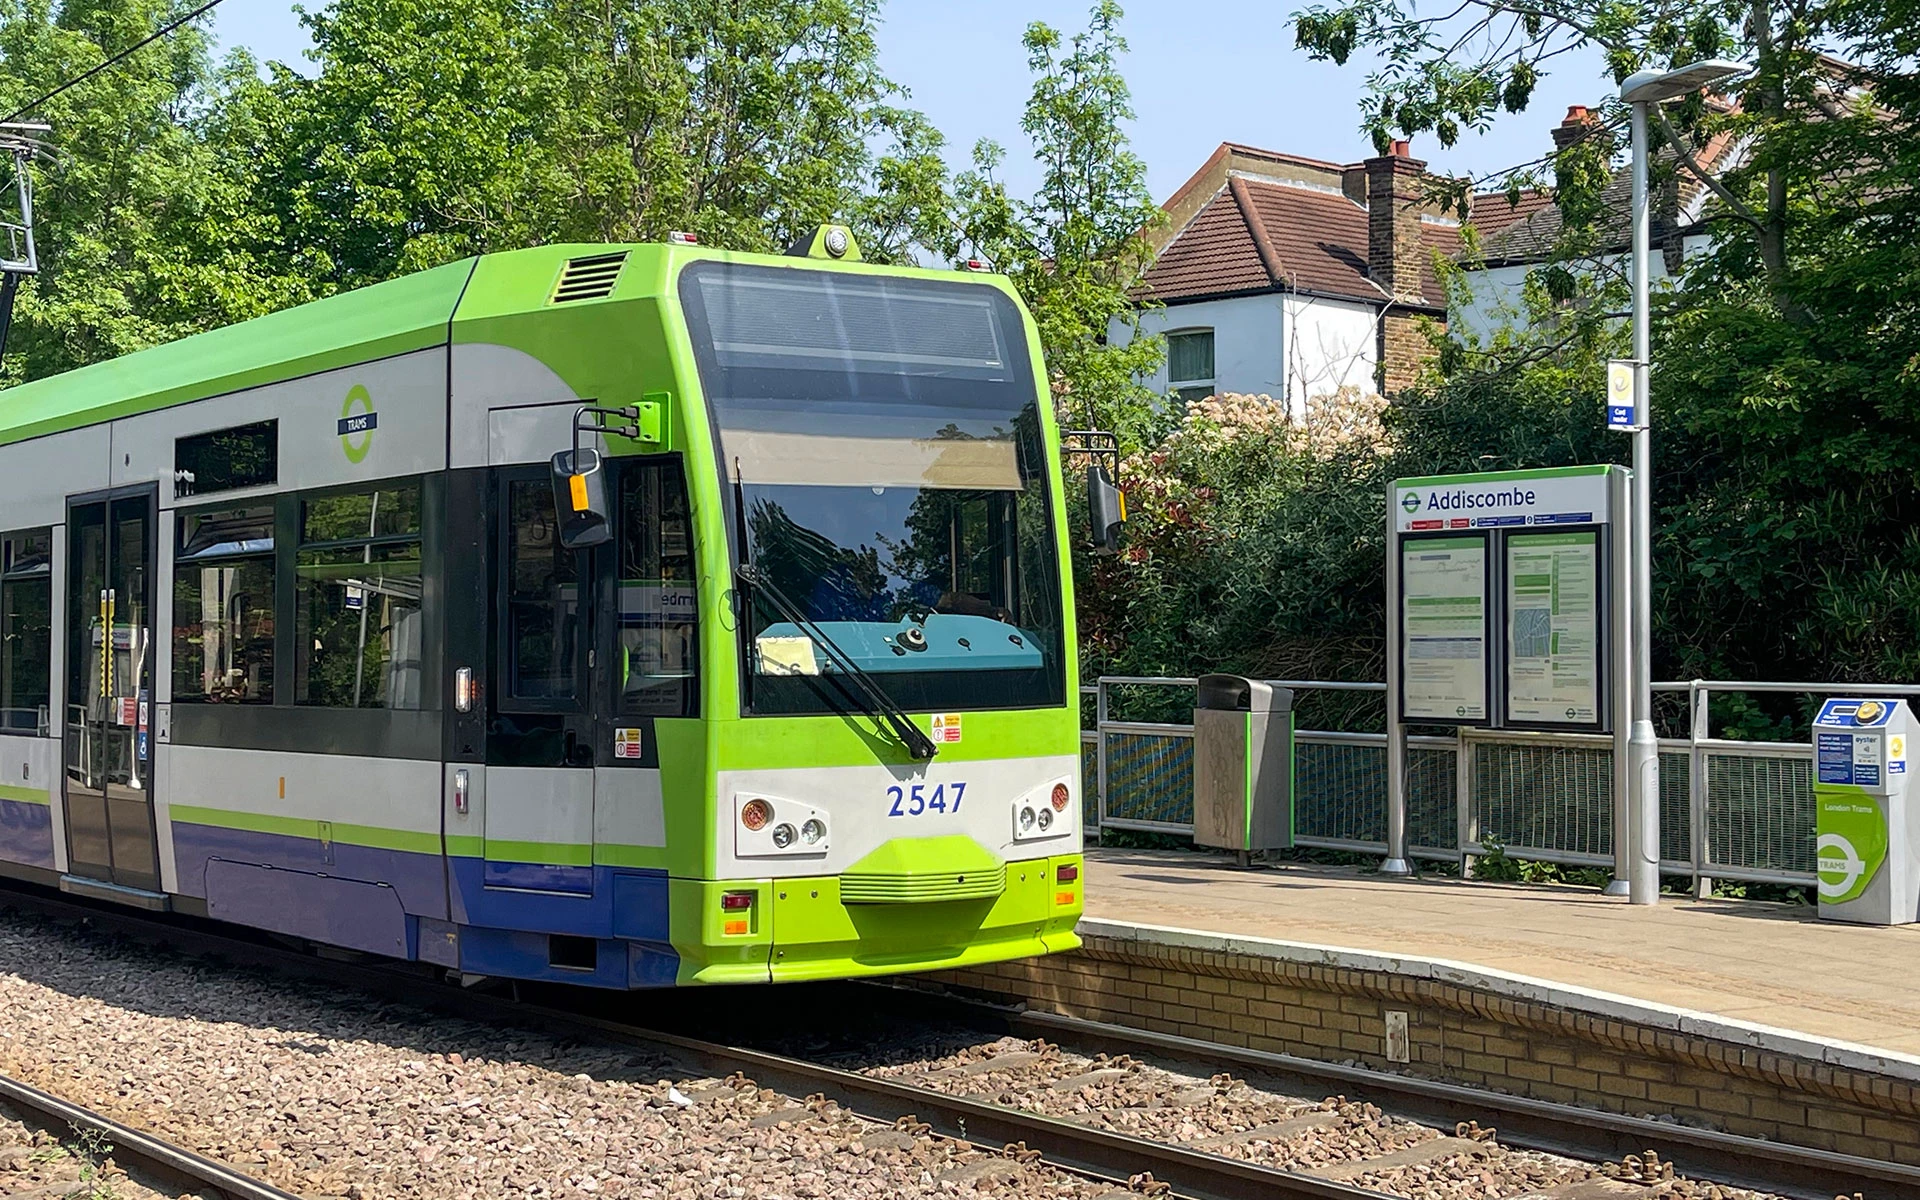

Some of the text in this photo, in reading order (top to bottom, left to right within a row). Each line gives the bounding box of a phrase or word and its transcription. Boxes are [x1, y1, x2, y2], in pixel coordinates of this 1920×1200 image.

[347, 417, 367, 431] TRAMS
[1427, 487, 1536, 510] Addiscombe
[887, 782, 967, 817] 2547
[1824, 804, 1872, 813] London Trams
[1819, 861, 1846, 870] TRAMS
